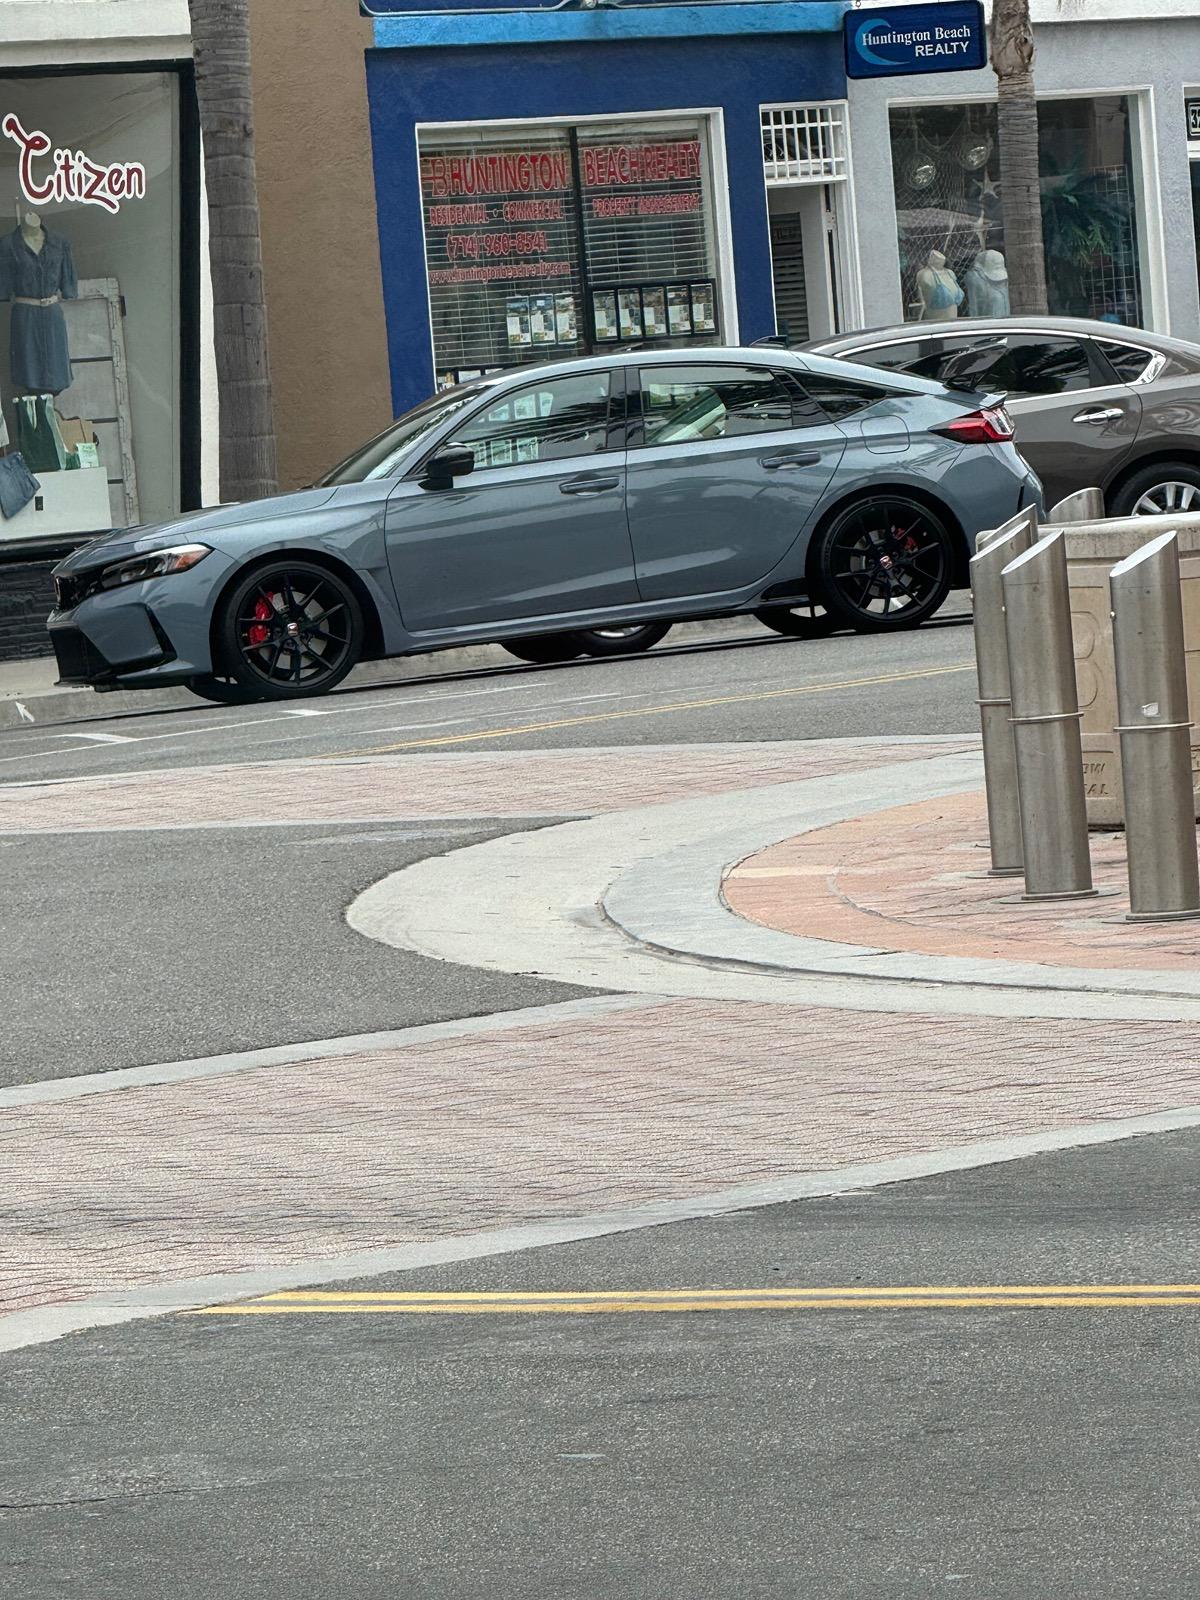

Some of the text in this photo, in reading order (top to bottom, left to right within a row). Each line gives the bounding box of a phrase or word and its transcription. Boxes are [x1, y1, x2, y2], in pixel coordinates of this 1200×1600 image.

[862, 25, 970, 46] Huntington Beach
[915, 41, 969, 57] REALTY
[2, 113, 145, 214] Citizen
[450, 141, 701, 196] HUNTINGTON BEACH REALTY
[429, 193, 699, 226] RESIDENTIAL COMMERCIAL PROPERTY MANAGEMENT
[446, 231, 548, 262] (714) 960-8541
